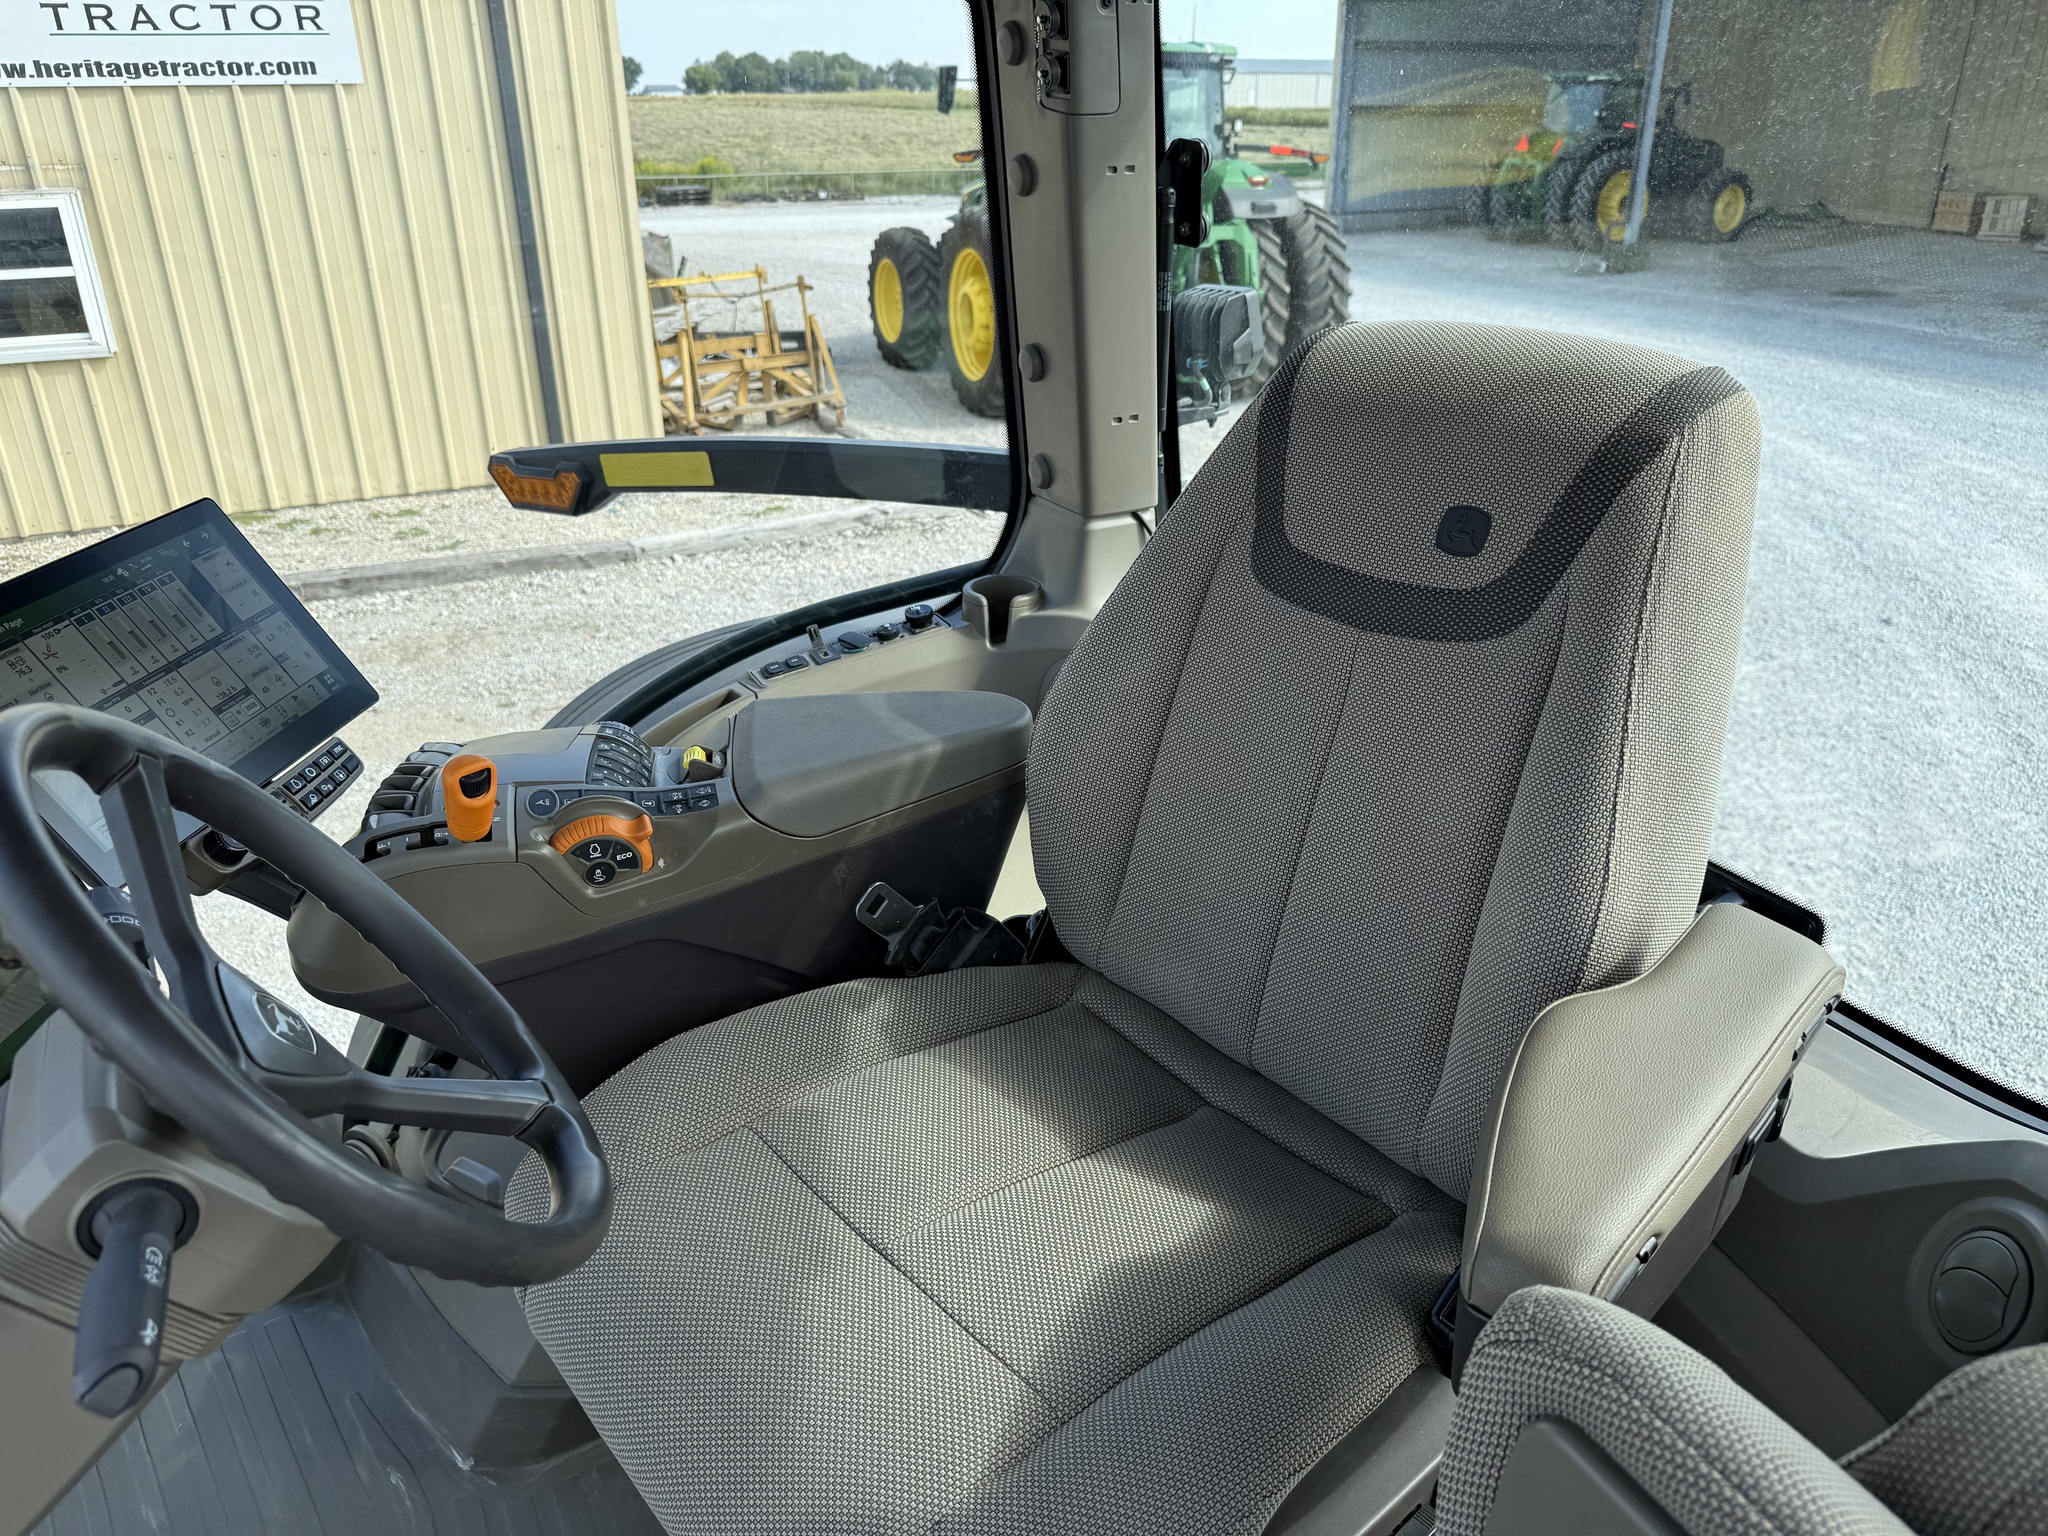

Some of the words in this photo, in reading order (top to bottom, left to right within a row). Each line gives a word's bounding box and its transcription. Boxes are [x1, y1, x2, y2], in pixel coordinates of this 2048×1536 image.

[39, 2, 324, 31] TRACTOR
[0, 59, 317, 79] w.heritagetractor.com
[3, 618, 24, 630] Page
[41, 629, 55, 640] 100
[56, 665, 69, 674] 0%
[163, 676, 178, 687] 18.6
[147, 687, 158, 696] F2
[157, 698, 166, 707] F1
[185, 728, 196, 738] R2
[203, 729, 222, 743] Manual
[616, 851, 633, 861] ECO
